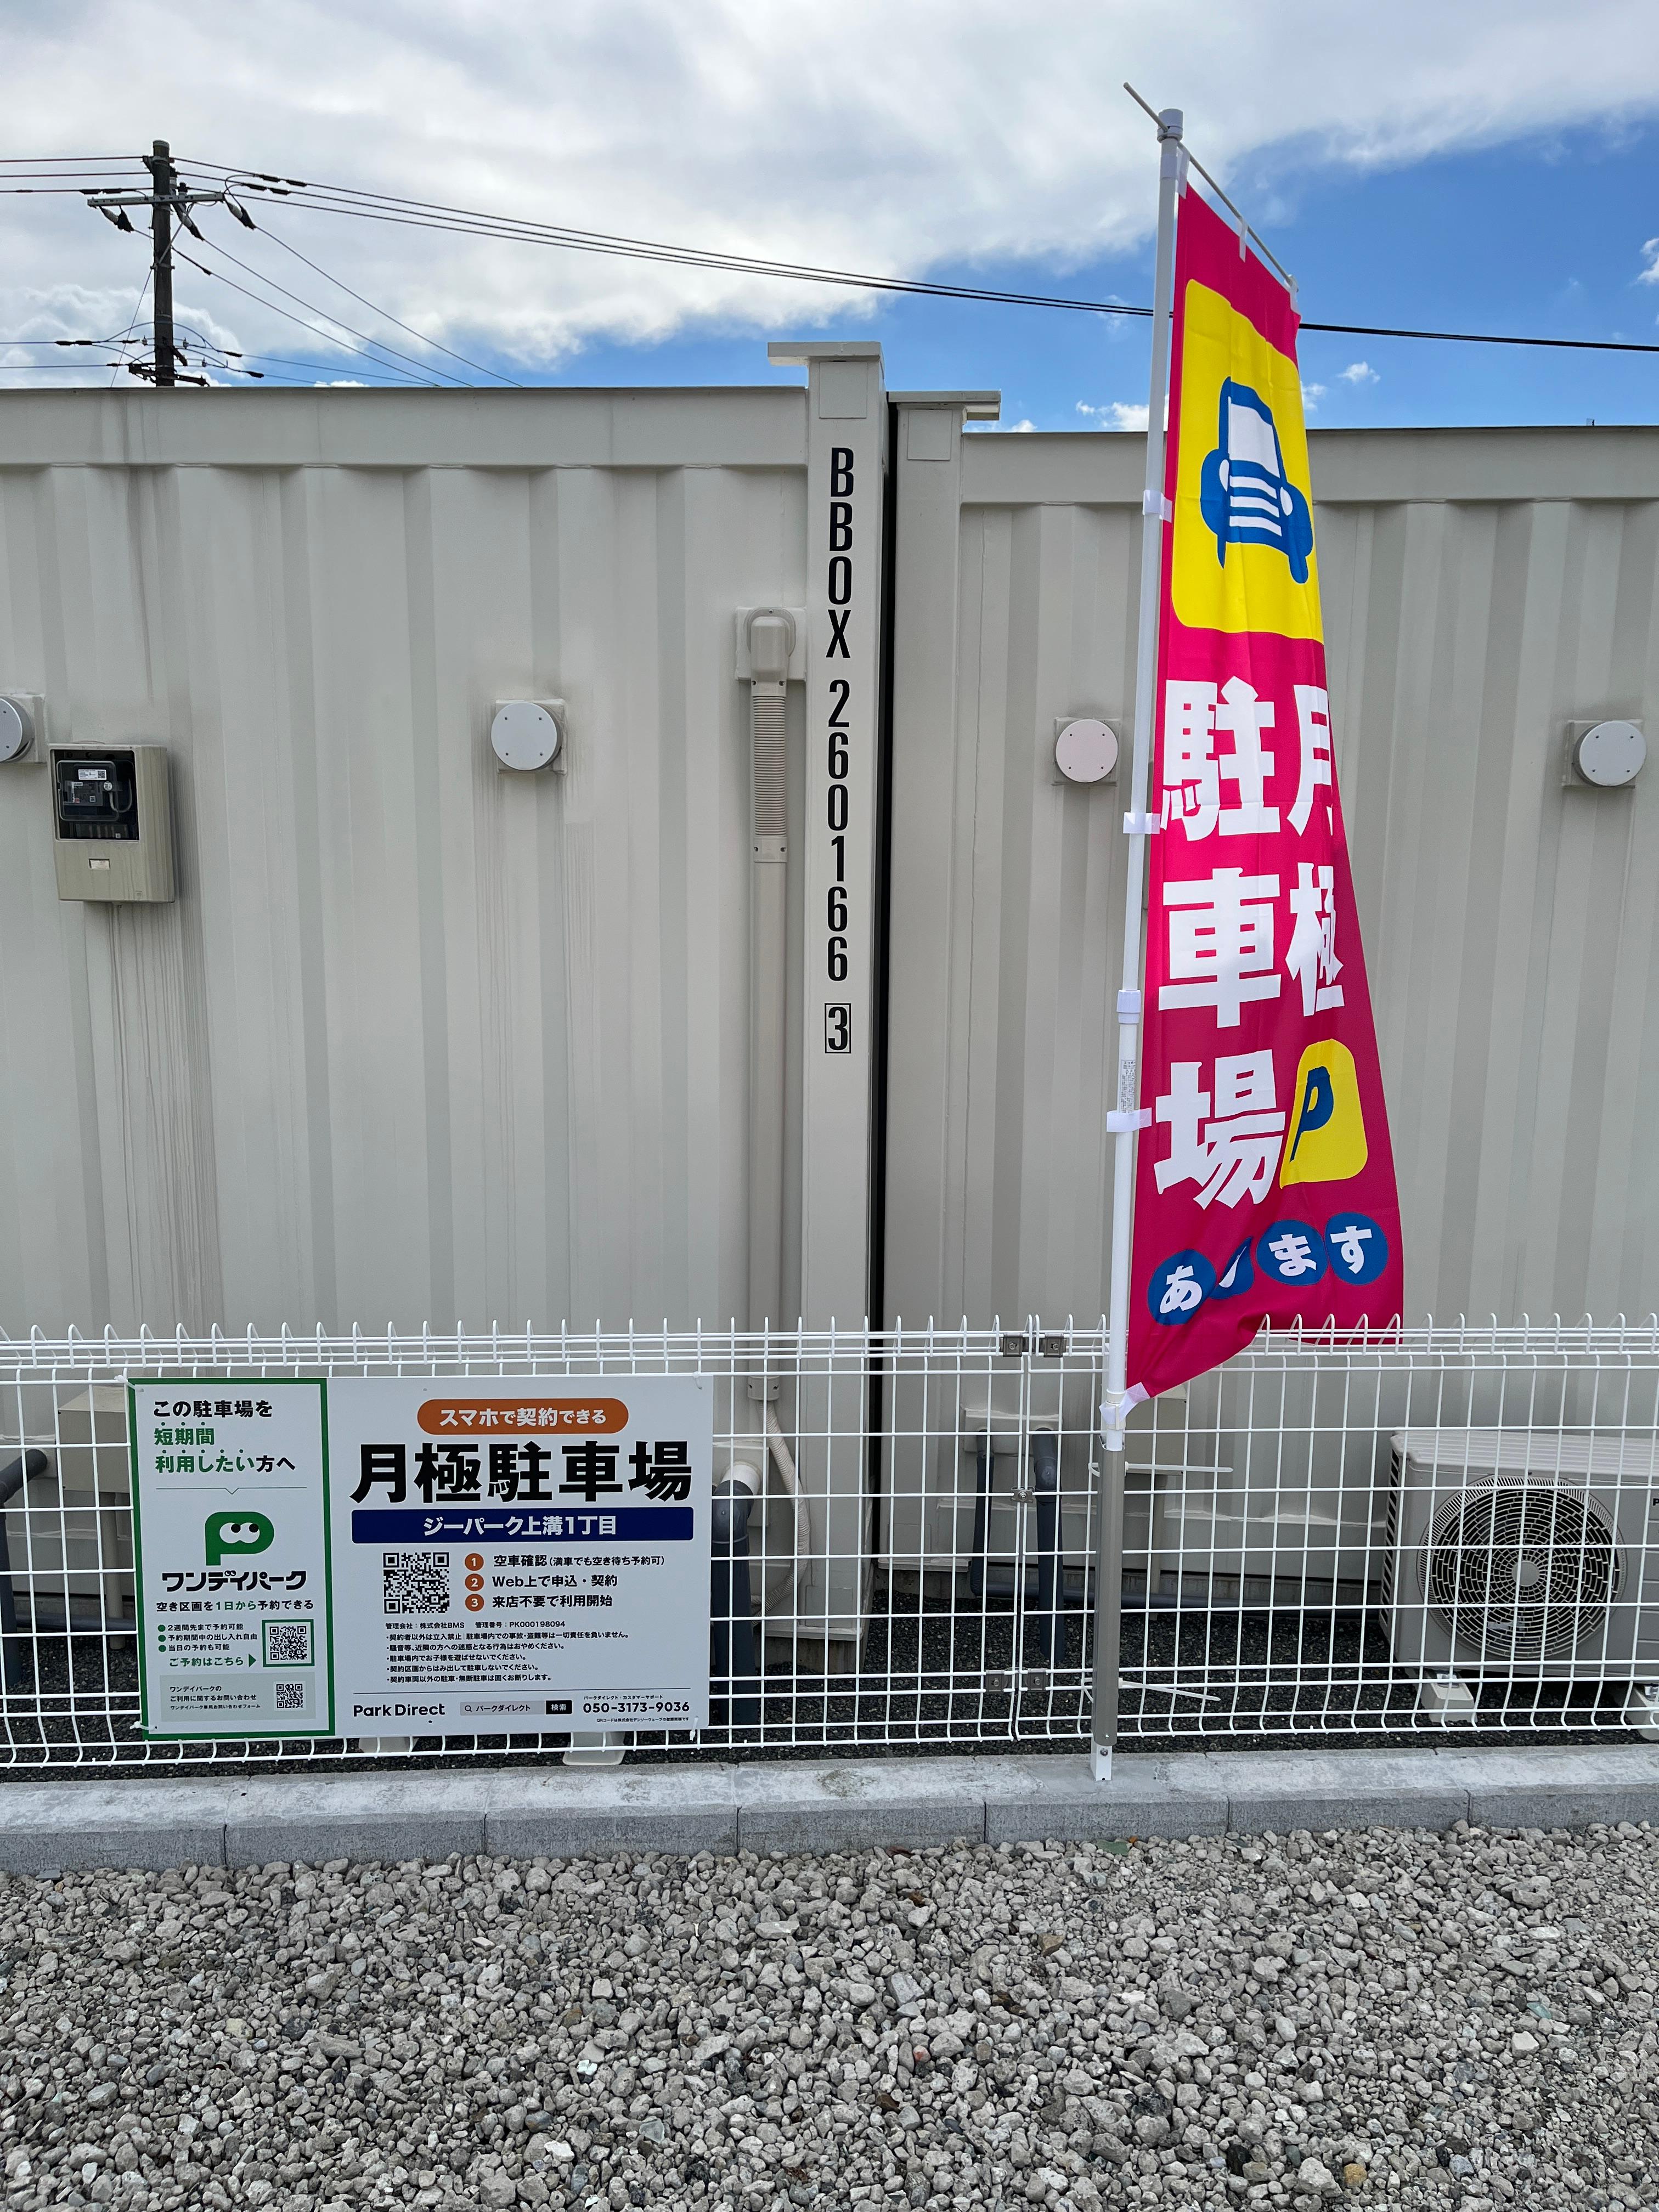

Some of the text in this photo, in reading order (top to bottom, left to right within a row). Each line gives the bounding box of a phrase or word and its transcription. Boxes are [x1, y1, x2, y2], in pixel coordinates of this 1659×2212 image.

[826, 448, 854, 1050] BBOX 260166 3
[1154, 675, 1286, 1210] 駐車場
[1290, 1066, 1334, 1163] P
[154, 1400, 273, 1418] この駐車場を
[440, 1408, 606, 1427] スマホで契約できる
[154, 1428, 215, 1446] 短期間
[155, 1455, 296, 1473] 利用したい方へ
[349, 1441, 692, 1504] 月極駐車場
[424, 1516, 616, 1536] ジーパーク上溝1丁目
[162, 1570, 306, 1592] ワンデイパーク
[156, 1599, 314, 1612] 空き区画を1日から予約できる
[492, 1595, 612, 1608] 来店不要で利用開始
[168, 1633, 257, 1641] 予約期間中の出し入れ自由
[170, 1657, 244, 1667] ご予約はこちら
[353, 1703, 445, 1717] Park Direct
[476, 1704, 531, 1712] パークダイレクト
[551, 1703, 567, 1712] 検索
[583, 1702, 690, 1713] 050-3173-9036
